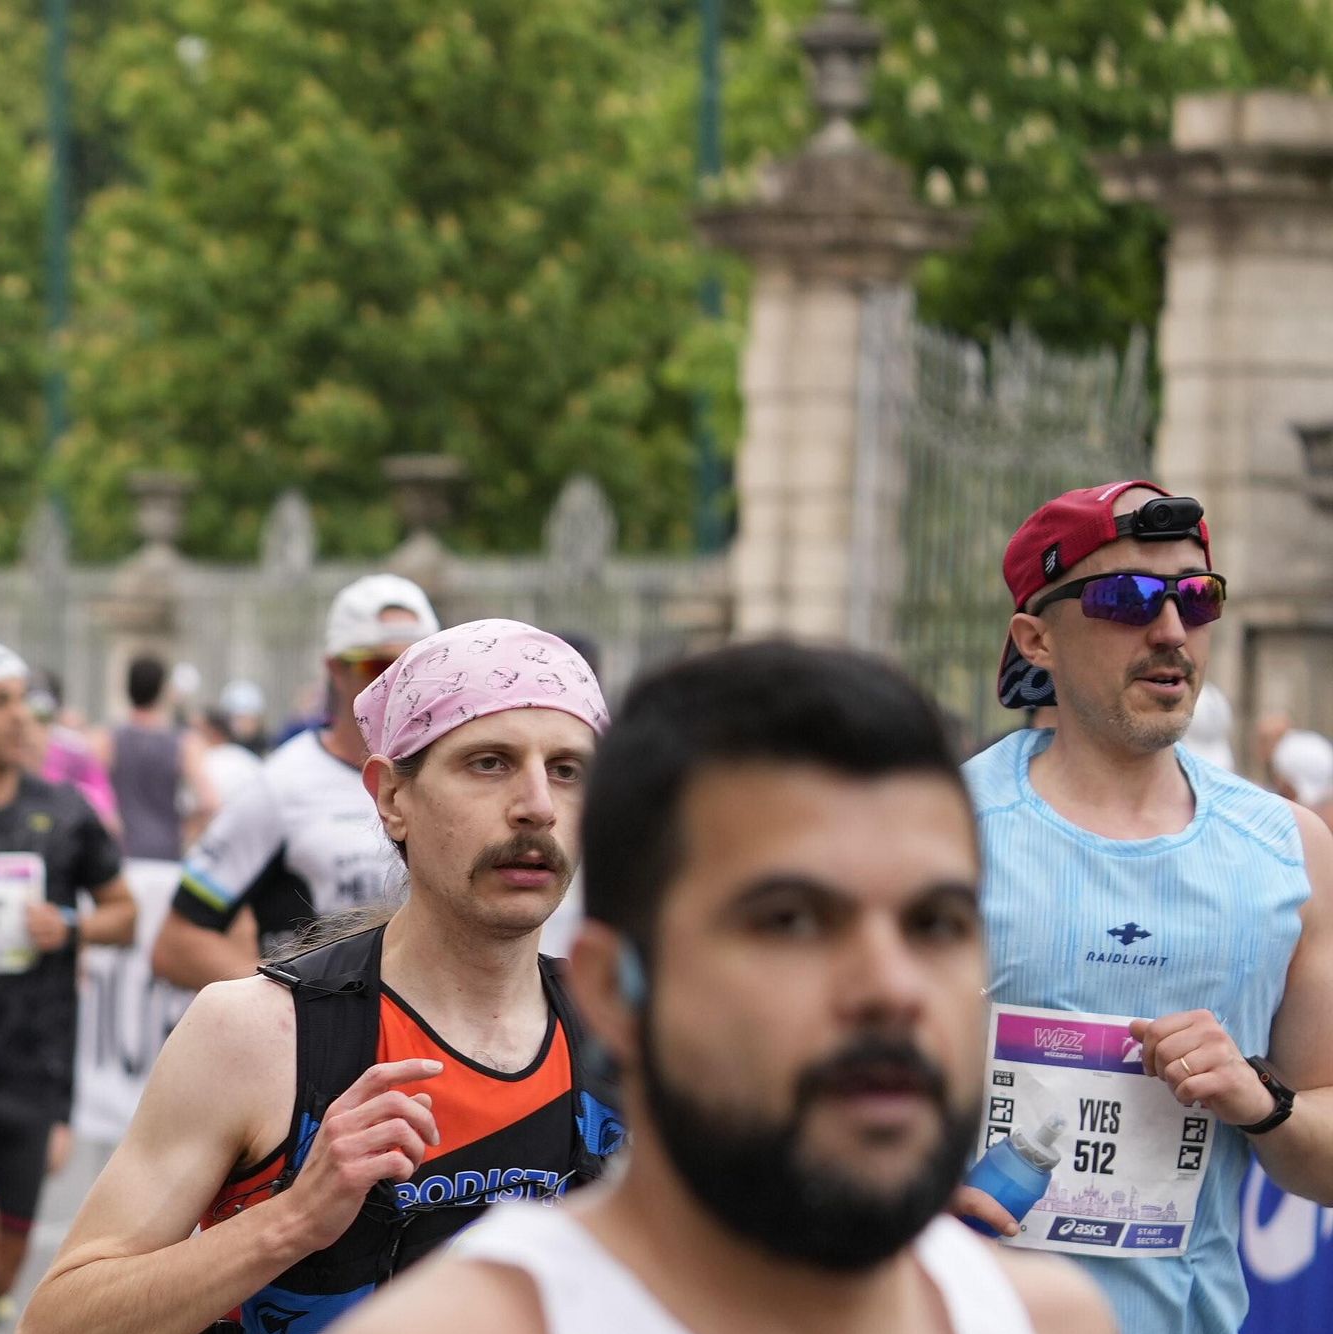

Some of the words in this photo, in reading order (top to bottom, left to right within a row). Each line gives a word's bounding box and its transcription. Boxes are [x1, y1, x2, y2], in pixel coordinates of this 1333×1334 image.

[1086, 951, 1169, 967] RAIDLIGHT
[1078, 1098, 1122, 1135] YVES
[1073, 1139, 1117, 1175] 512
[1074, 1223, 1108, 1237] asics
[1137, 1227, 1163, 1236] START
